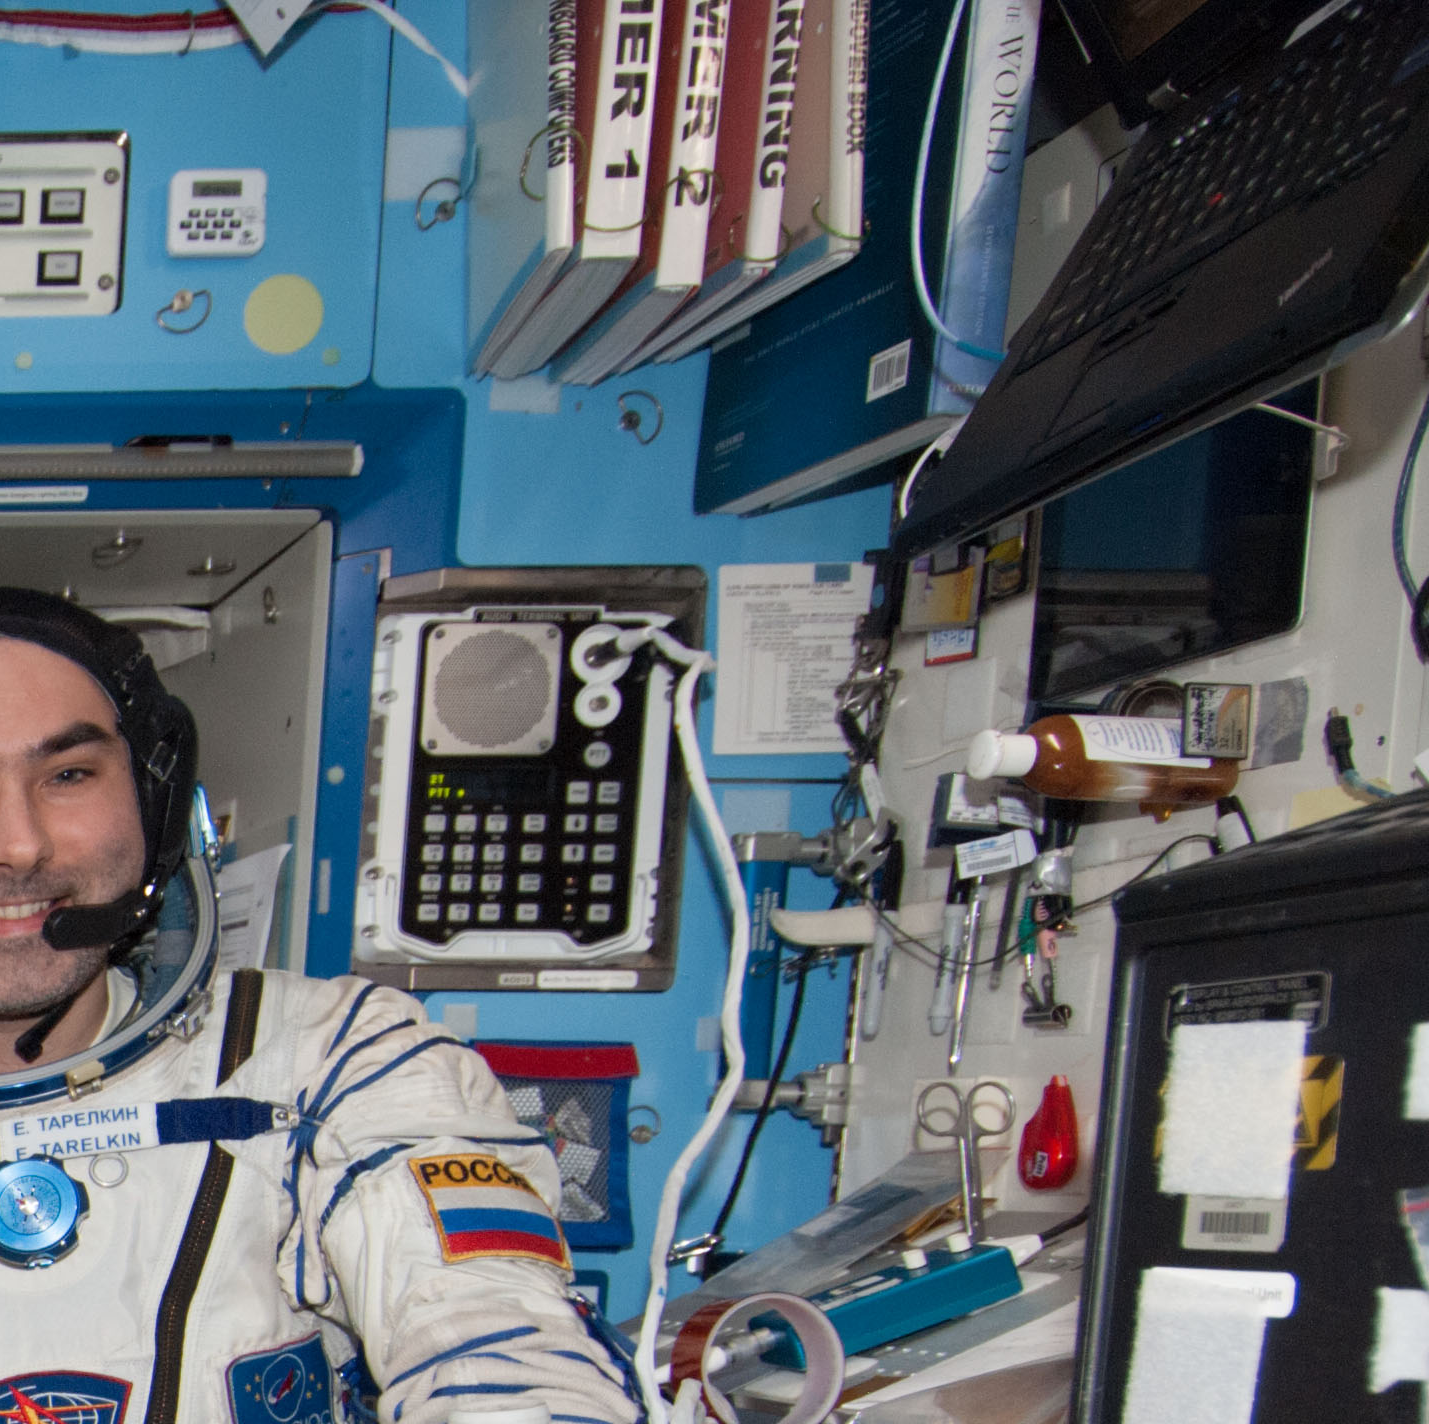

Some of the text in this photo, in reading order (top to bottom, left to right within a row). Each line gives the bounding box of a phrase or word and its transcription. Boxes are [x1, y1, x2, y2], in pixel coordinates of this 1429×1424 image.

[759, 0, 804, 188] RNING
[985, 35, 1025, 174] WORLD
[845, 91, 869, 155] BOOK
[605, 149, 640, 178] 1
[675, 166, 711, 206] 2
[428, 787, 451, 799] PTT
[38, 1106, 139, 1131] ТАРЕЛКИН
[38, 1132, 141, 1155] TARELKIN
[420, 1159, 532, 1189] РОСС
